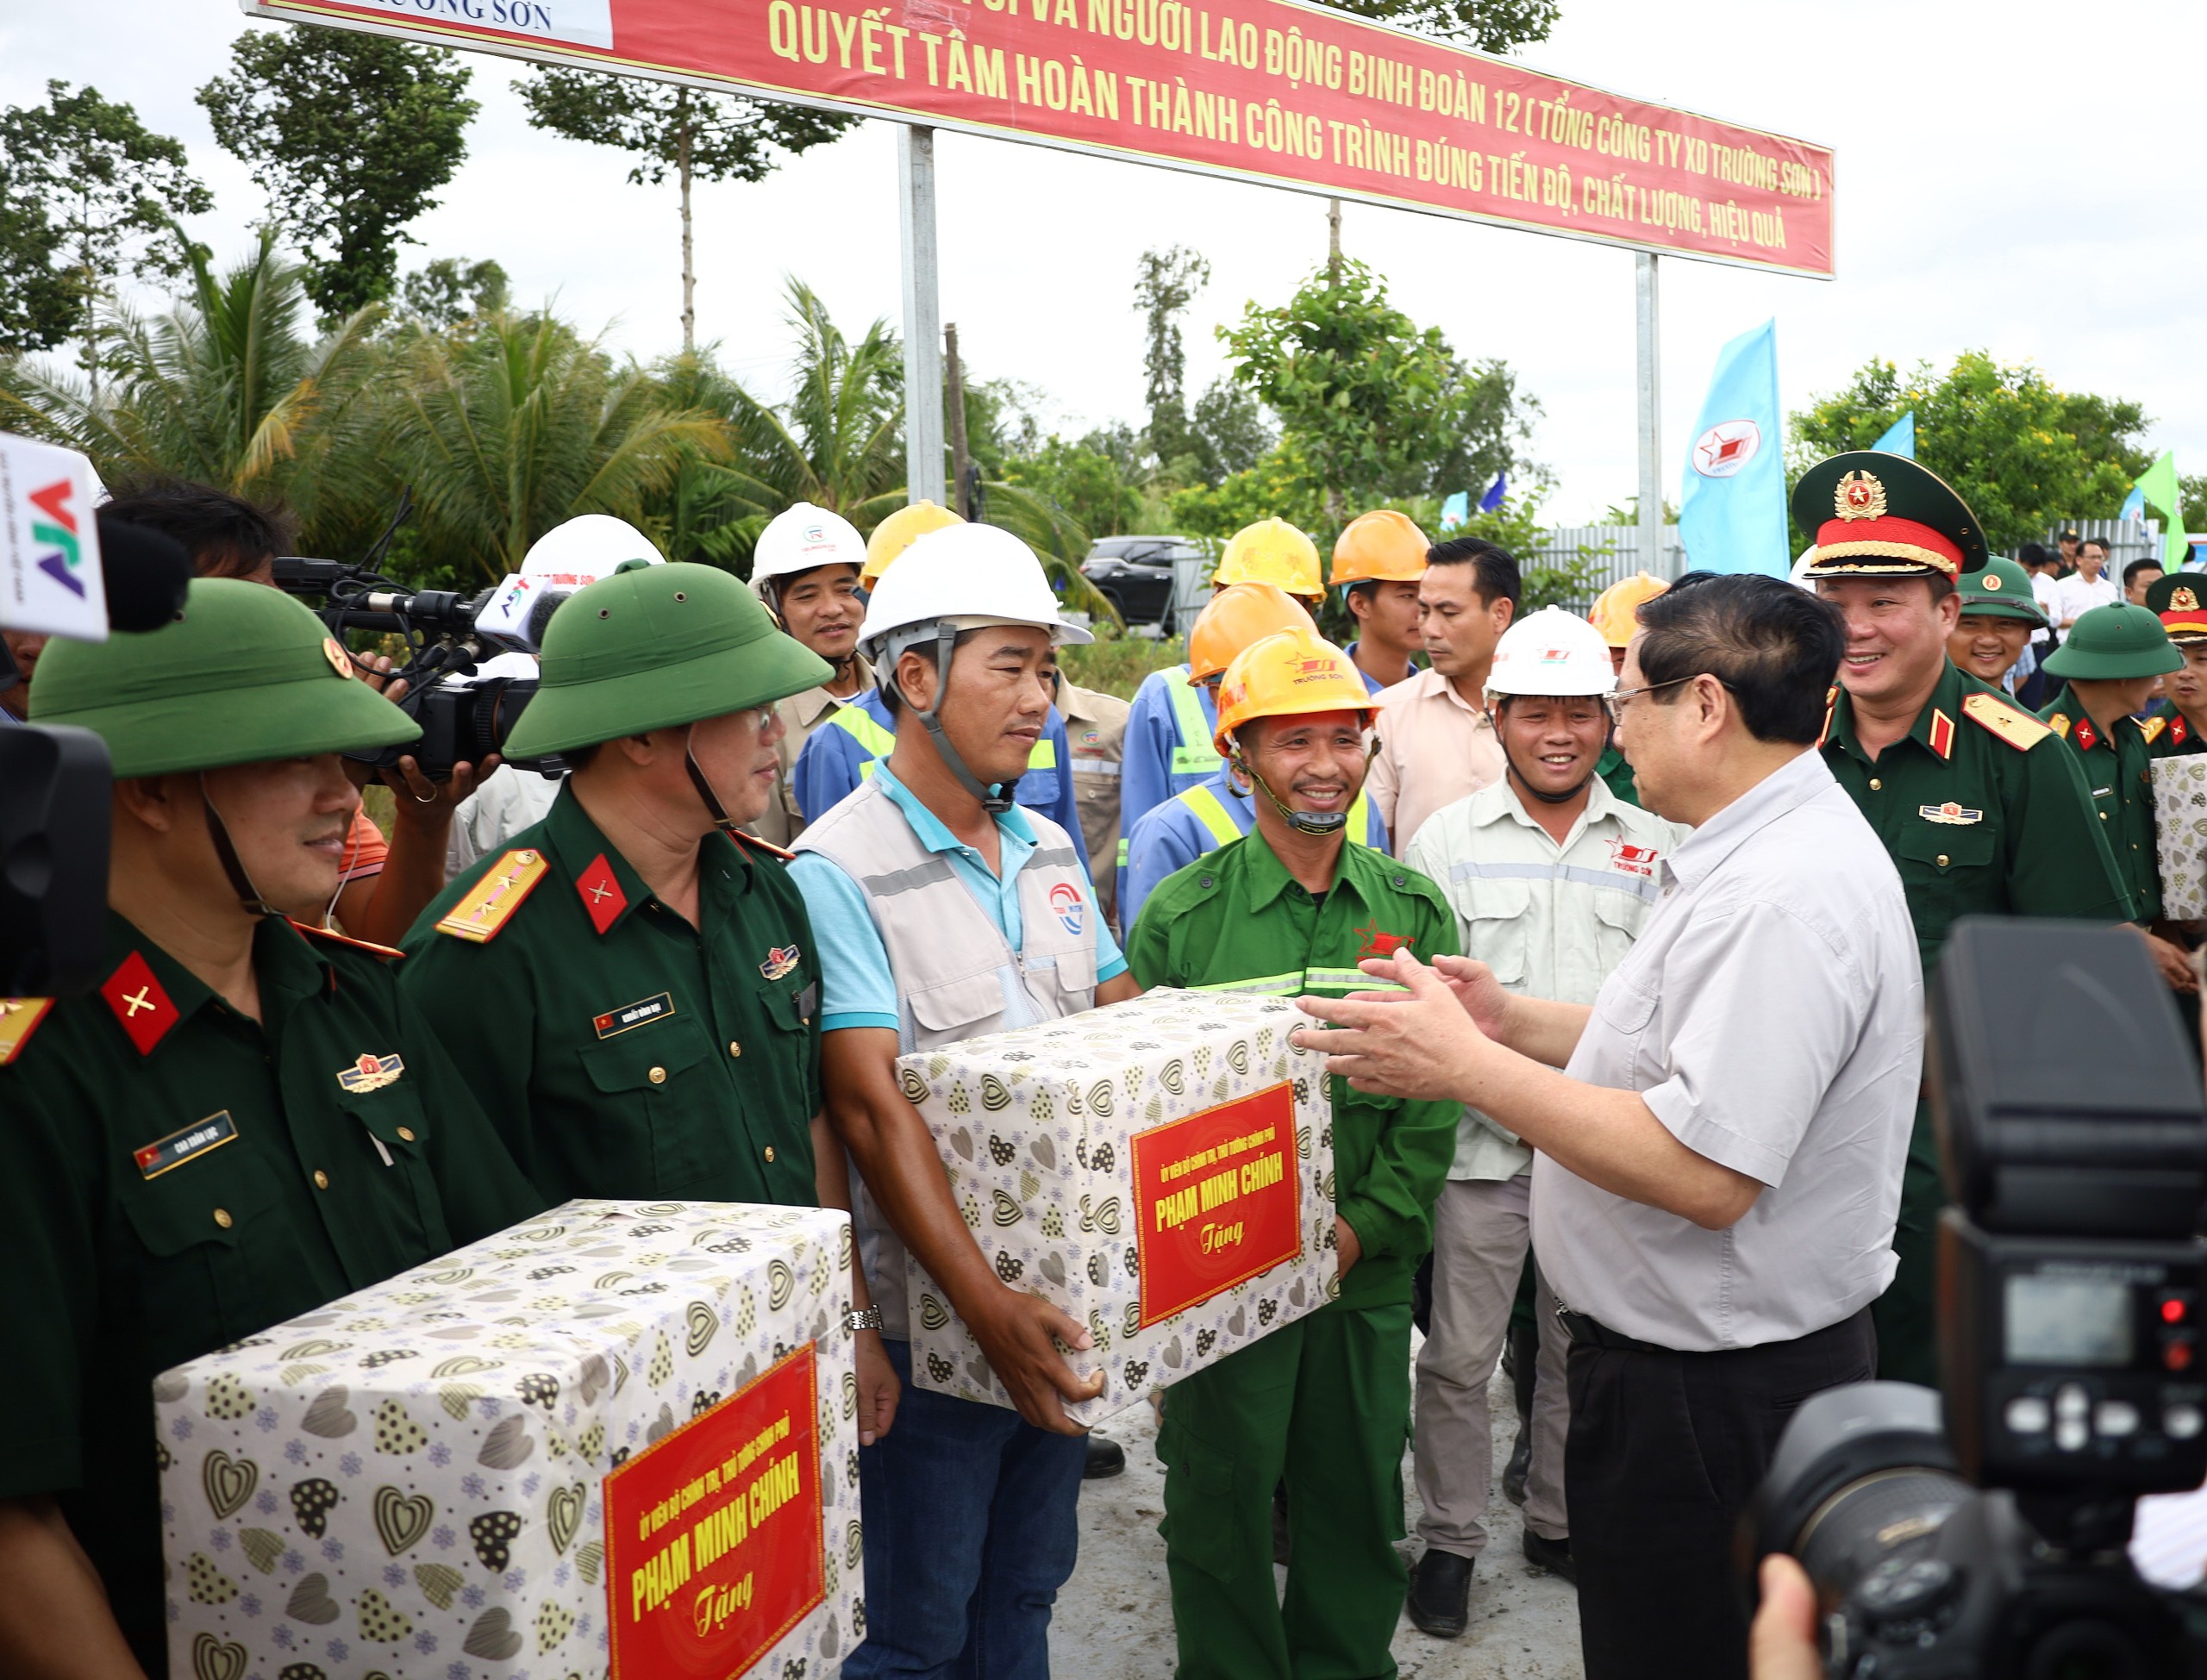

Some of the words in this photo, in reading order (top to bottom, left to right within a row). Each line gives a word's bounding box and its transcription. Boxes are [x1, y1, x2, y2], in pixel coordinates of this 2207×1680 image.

[493, 0, 553, 31] SƠN
[768, 0, 910, 79] QUYẾT
[918, 28, 1008, 99] TÂM
[1016, 53, 1120, 121] HOÀN
[1125, 76, 1239, 144] THÀNH
[1246, 98, 1322, 161] CÔNG
[1329, 119, 1410, 178] TRÌNH
[1416, 136, 1483, 191] ĐÚNG
[1487, 151, 1538, 204] TIẾN
[1542, 163, 1579, 217] ĐỘ,
[1583, 172, 1636, 222] CHẤT
[1640, 188, 1707, 239] LƯỢNG,
[1710, 200, 1749, 247] HIỆU
[1752, 205, 1786, 249] QUẢ
[1201, 11, 1258, 70] LAO
[1265, 25, 1342, 90] ĐỘNG
[1349, 51, 1413, 106] BINH
[1419, 70, 1486, 125] ĐOÀN
[1494, 89, 1521, 133] 12
[1539, 90, 1594, 150] TỔNG
[1597, 112, 1651, 163] CÔNG
[1654, 129, 1682, 168] TY
[1685, 135, 1708, 175] XD
[1710, 144, 1778, 191] TRƯỜNG
[1779, 161, 1811, 199] SƠN
[28, 475, 88, 601] VTV
[1155, 1185, 1198, 1232] PHẠM
[1200, 1168, 1238, 1213] MINH
[1241, 1152, 1284, 1196] CHÍNH
[1200, 1220, 1244, 1255] Tặng
[632, 1532, 690, 1623] PHẠM
[694, 1492, 747, 1572] MINH
[749, 1451, 800, 1529] CHÍNH
[693, 1571, 753, 1638] Tặng
